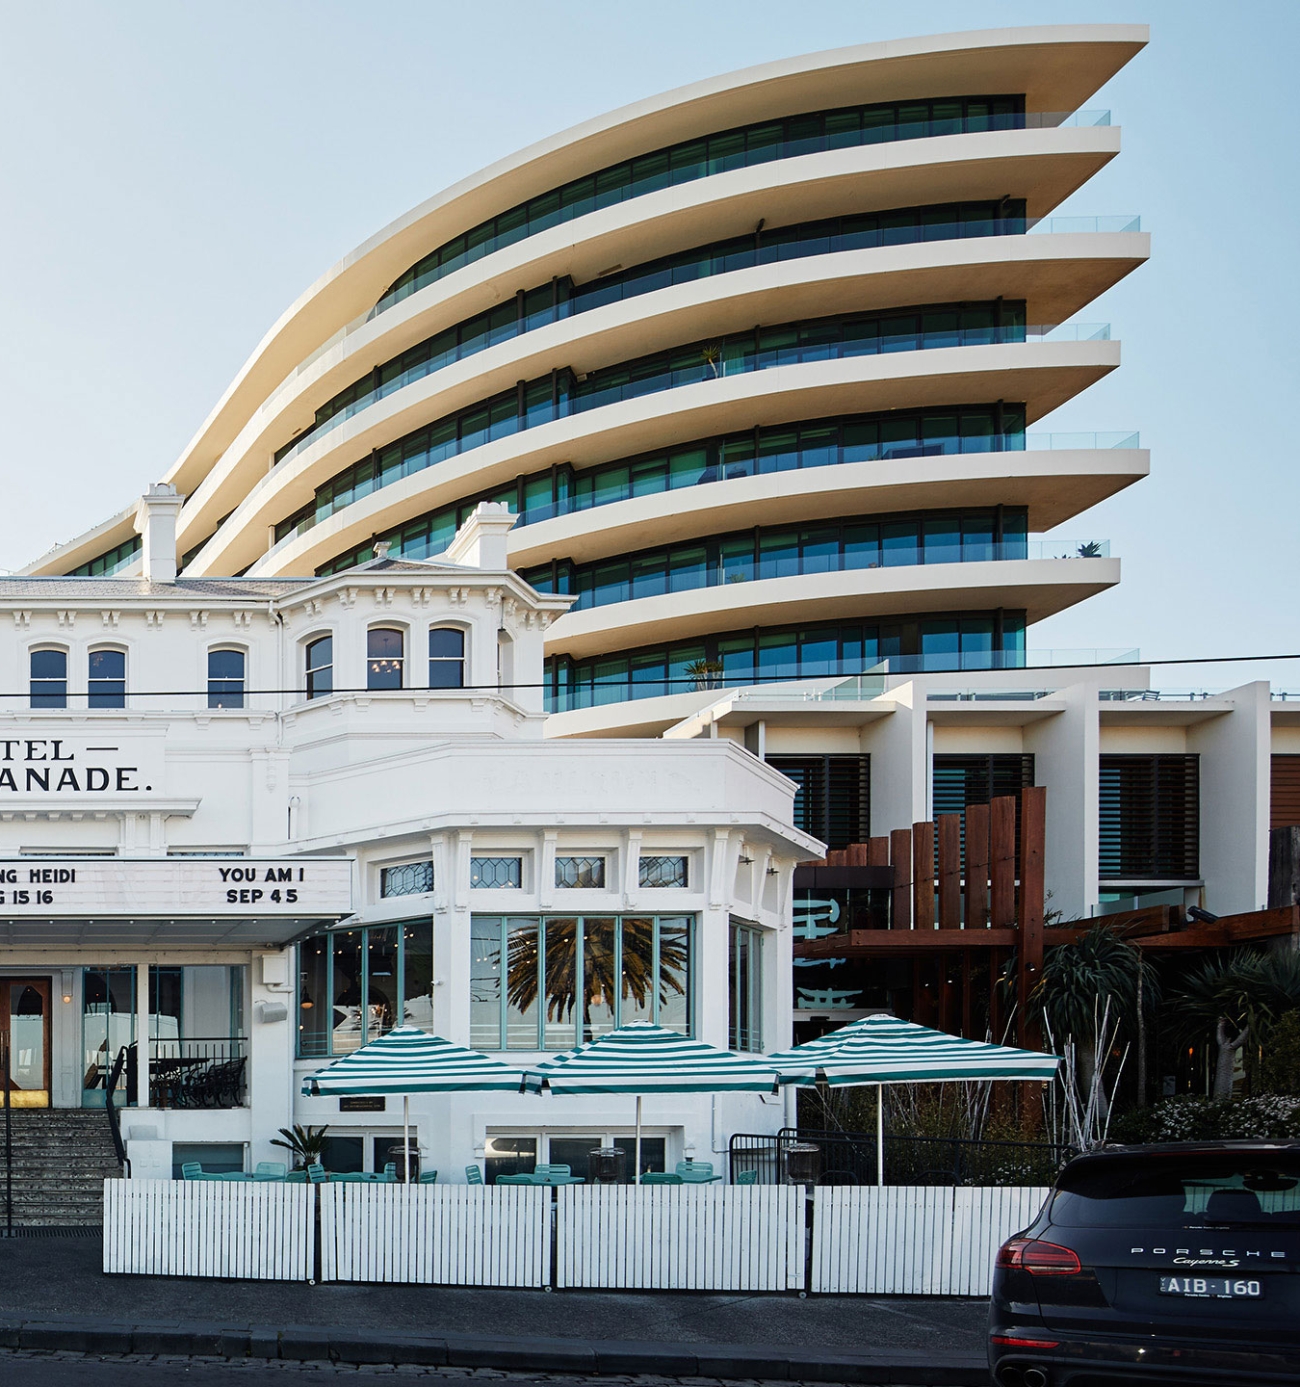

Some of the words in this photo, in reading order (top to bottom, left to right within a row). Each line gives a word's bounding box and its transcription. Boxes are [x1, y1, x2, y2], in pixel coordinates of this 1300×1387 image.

[29, 868, 76, 883] HEIDI
[219, 868, 256, 883] YOU
[264, 868, 292, 883] AM
[299, 868, 304, 882] I
[12, 890, 30, 905] 15
[36, 890, 54, 905] 16
[226, 889, 264, 904] SEP
[270, 889, 282, 903] 4
[285, 889, 298, 903] 5
[1130, 1247, 1286, 1258] PORSCHE
[1172, 1257, 1226, 1267] Cayenne
